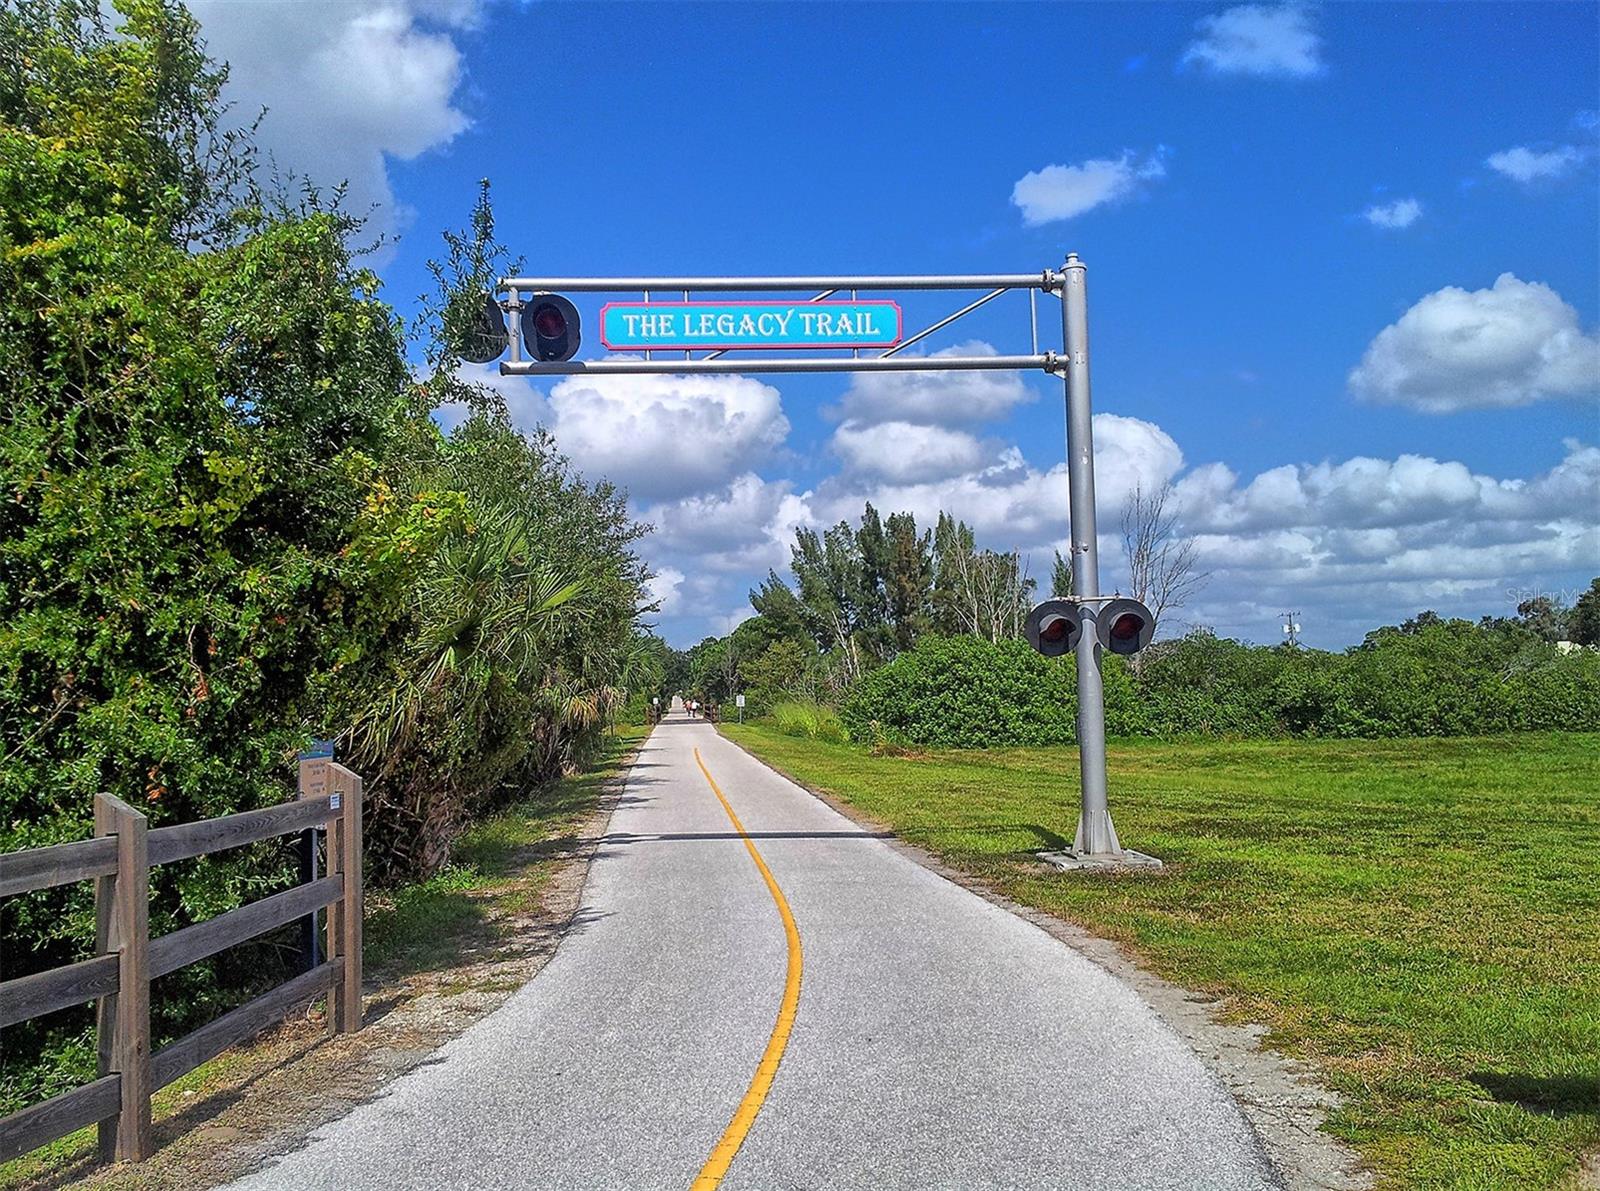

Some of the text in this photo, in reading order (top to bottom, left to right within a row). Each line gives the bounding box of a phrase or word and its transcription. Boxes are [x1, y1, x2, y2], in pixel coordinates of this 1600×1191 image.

[622, 308, 881, 337] THE LEGACY TRAIL
